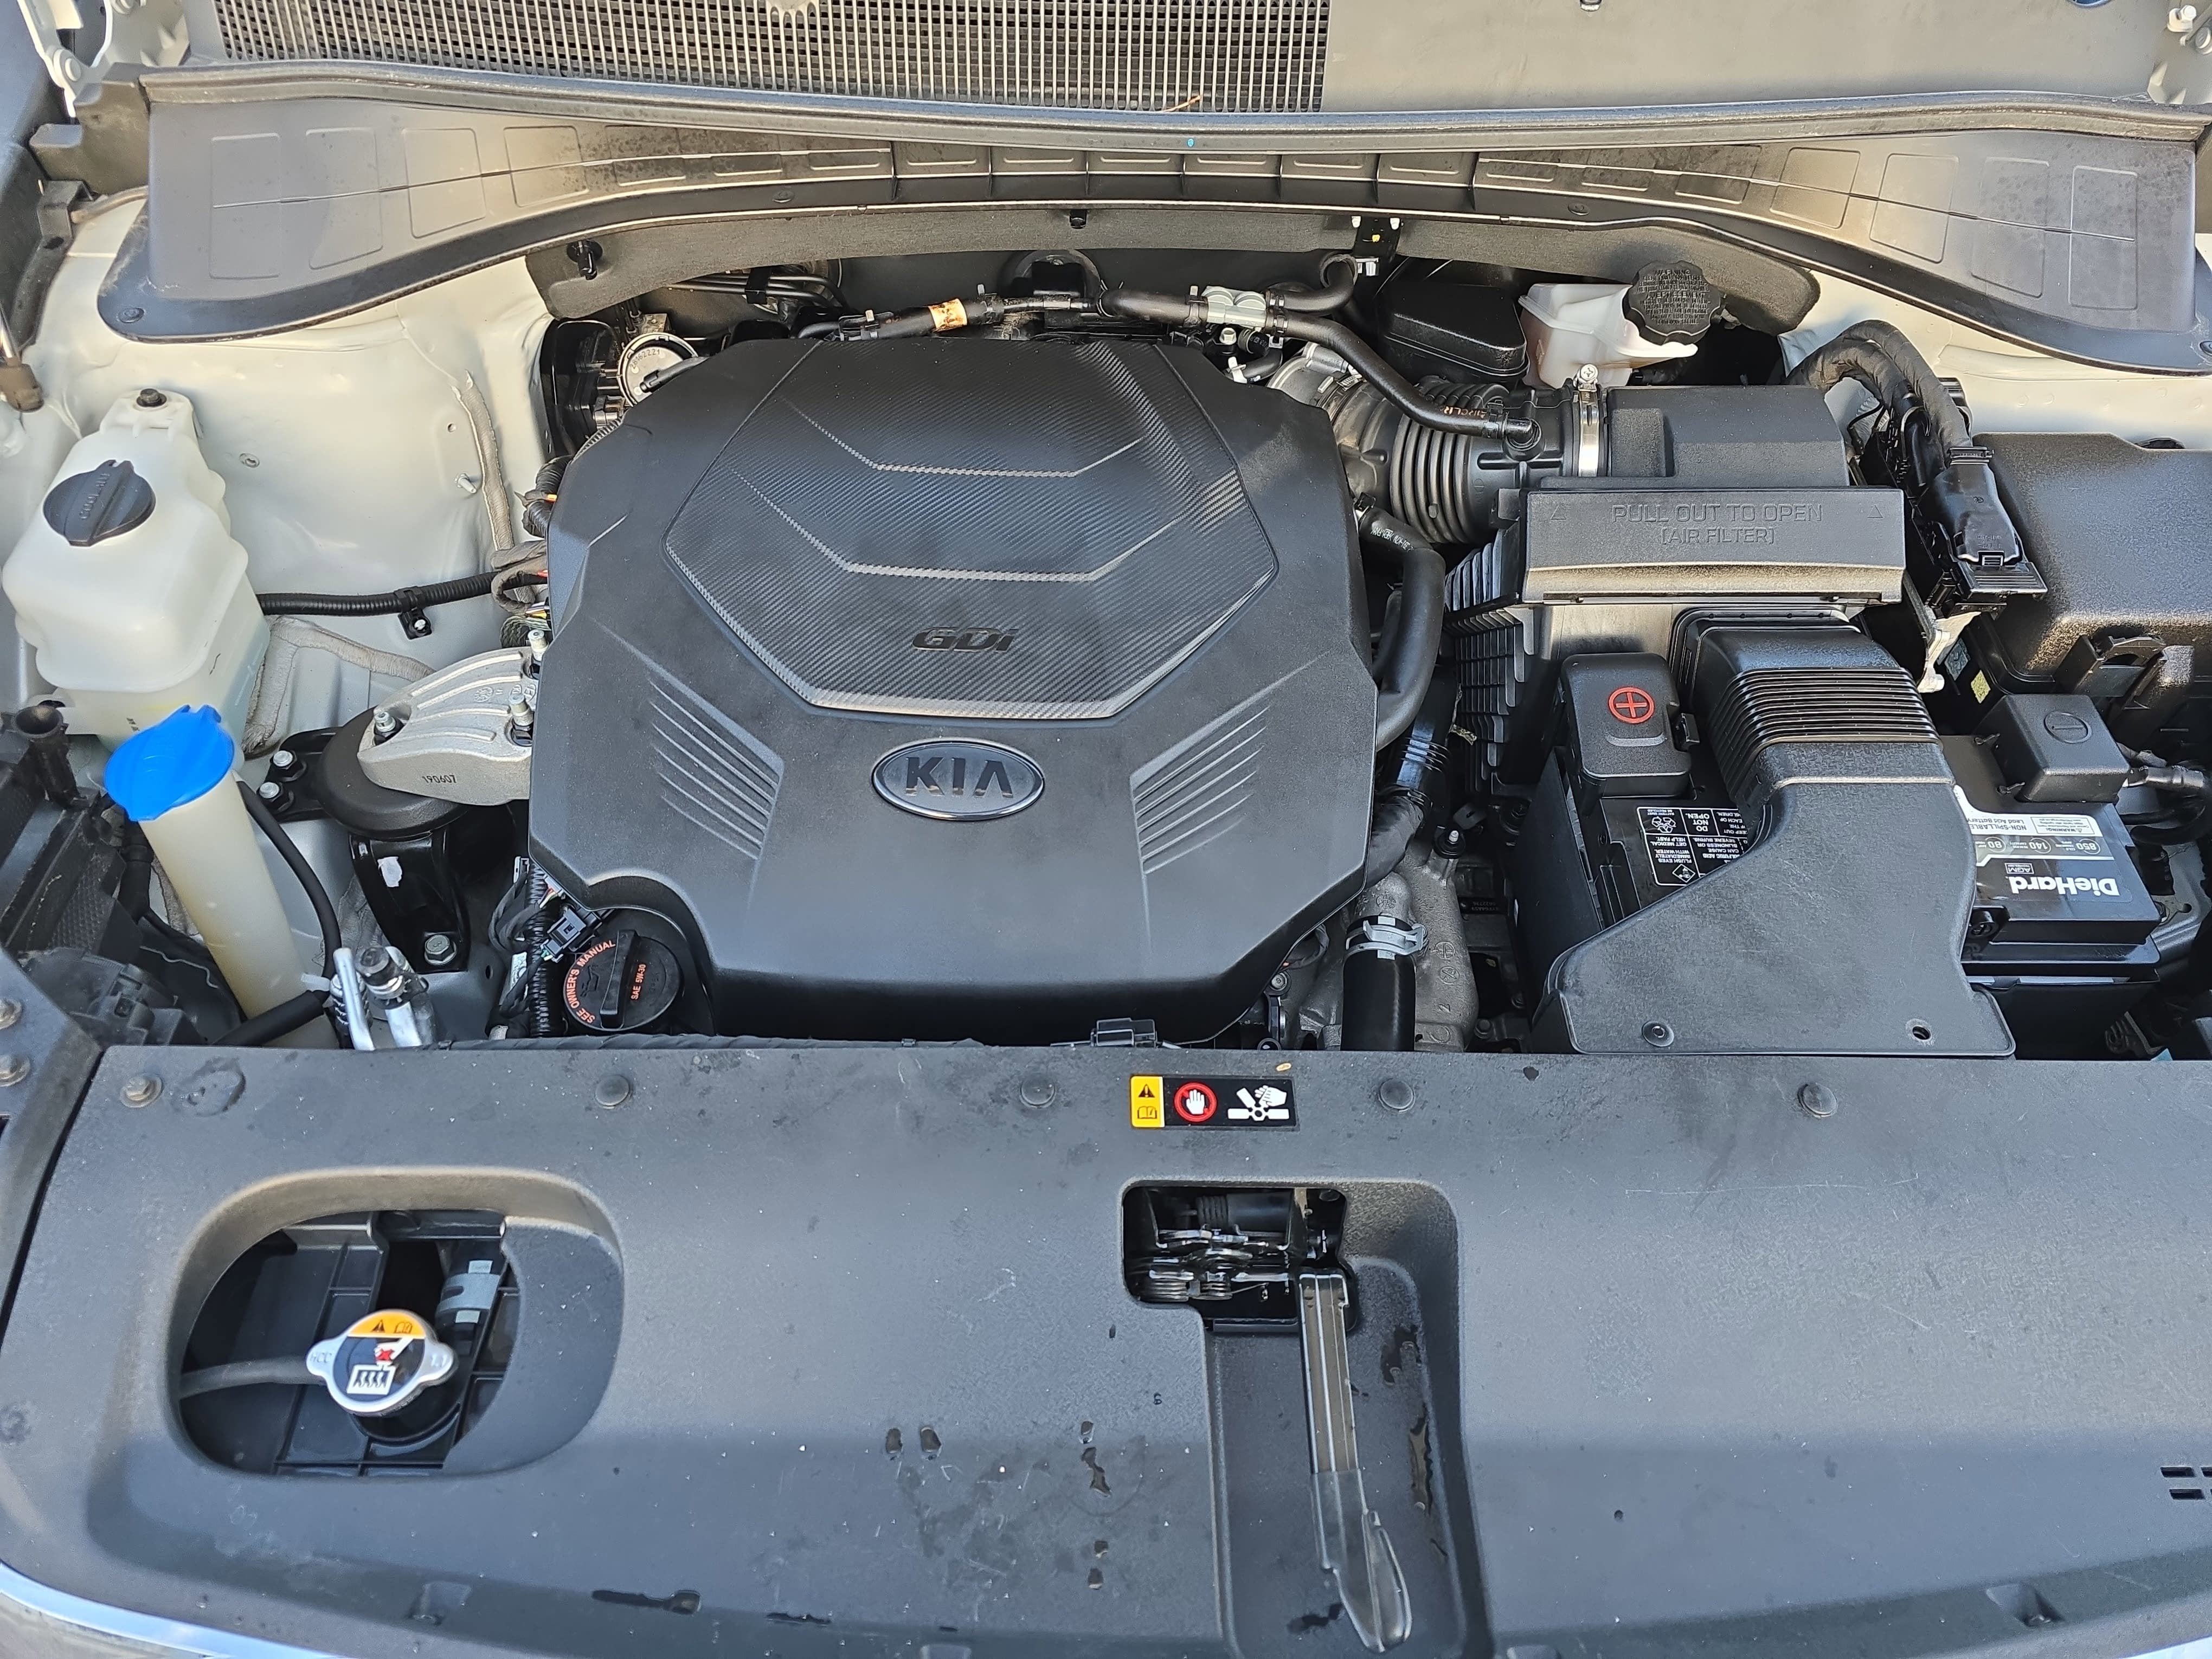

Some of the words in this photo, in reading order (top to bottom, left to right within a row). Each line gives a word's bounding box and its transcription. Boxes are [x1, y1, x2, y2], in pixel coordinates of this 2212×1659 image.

[1612, 505, 1669, 523] PULL
[1675, 504, 1720, 522] OUT
[1726, 504, 1756, 522] TO
[1764, 504, 1823, 522] OPEN
[421, 775, 457, 784] 190607
[905, 756, 1014, 799] KIA
[2029, 841, 2048, 850] 140
[2076, 843, 2097, 851] 850
[2010, 876, 2120, 897] DieHard
[576, 940, 616, 967] MANUAL
[635, 964, 646, 983] 5W-30
[567, 969, 580, 1009] OWNER'S
[631, 986, 641, 1000] SAE
[576, 1007, 595, 1024] SEE
[310, 1352, 332, 1362] HCC
